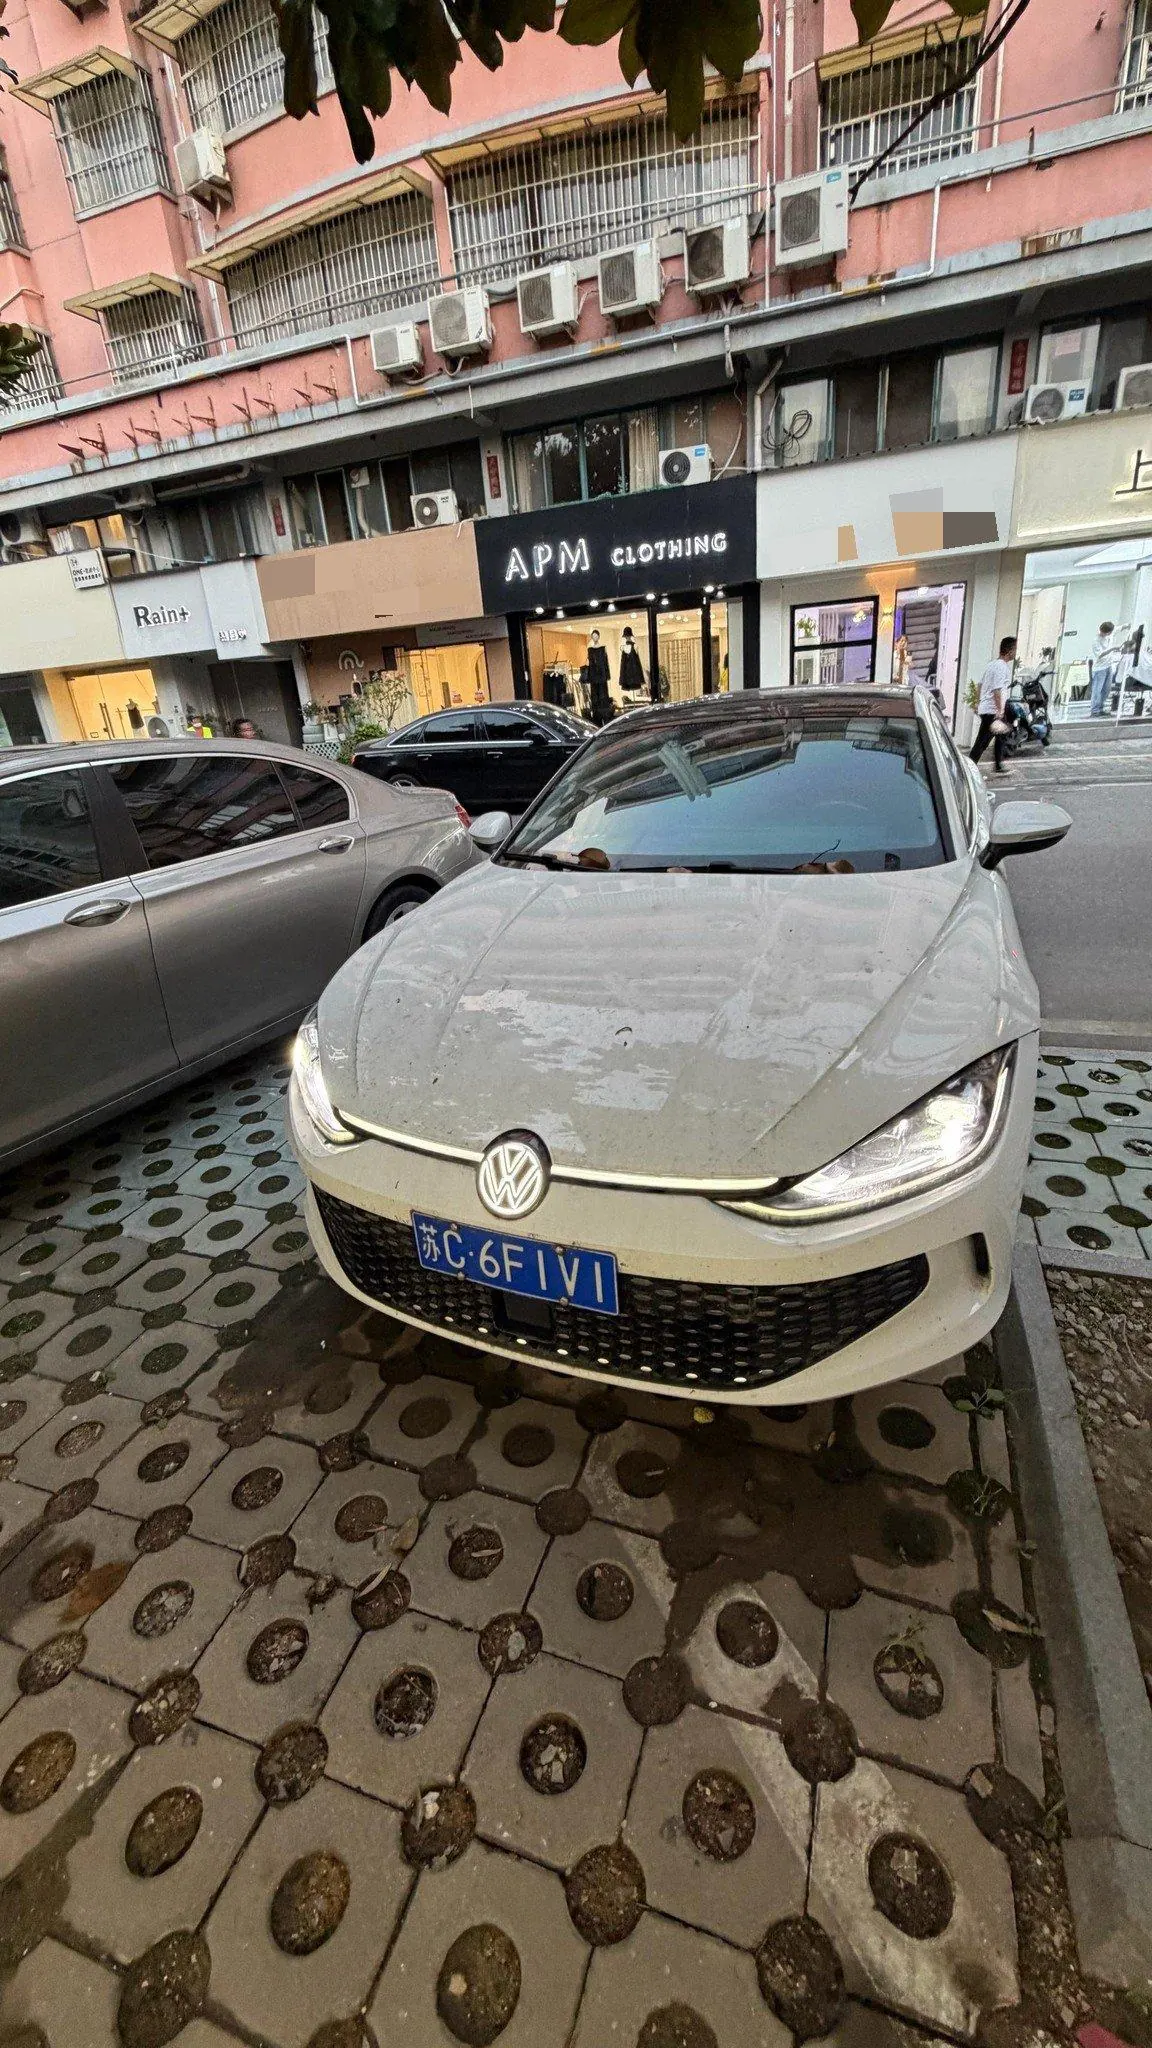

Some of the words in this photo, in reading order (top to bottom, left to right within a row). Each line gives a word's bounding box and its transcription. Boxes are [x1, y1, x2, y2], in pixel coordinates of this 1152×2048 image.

[504, 537, 590, 582] APM
[610, 532, 728, 567] CLOTHING
[133, 604, 190, 628] Rain+
